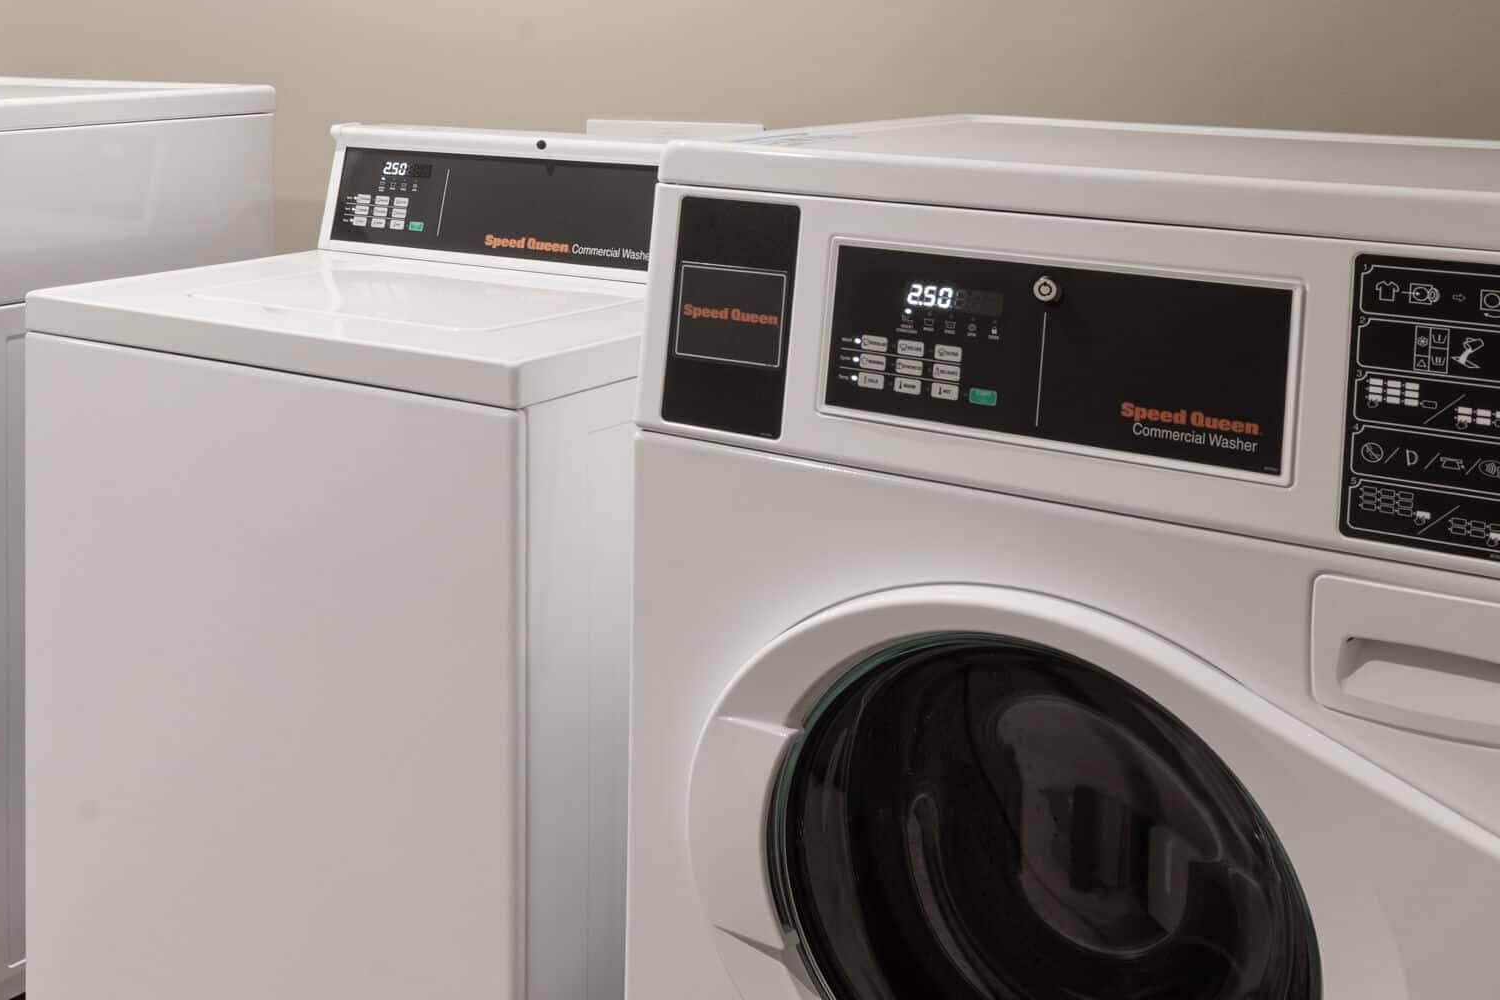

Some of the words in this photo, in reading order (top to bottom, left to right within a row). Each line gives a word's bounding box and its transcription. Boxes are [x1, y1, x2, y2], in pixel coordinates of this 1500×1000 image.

[485, 234, 526, 249] Speed
[527, 237, 569, 253] Queen
[572, 243, 620, 258] Commercial
[621, 248, 651, 261] Washe
[907, 283, 953, 309] 2.50
[684, 303, 729, 319] Speed
[731, 308, 778, 325] Queen
[1120, 401, 1187, 425] Speed
[1190, 411, 1260, 435] Queen
[1132, 422, 1205, 445] Commercial
[1208, 433, 1259, 454] Washer
